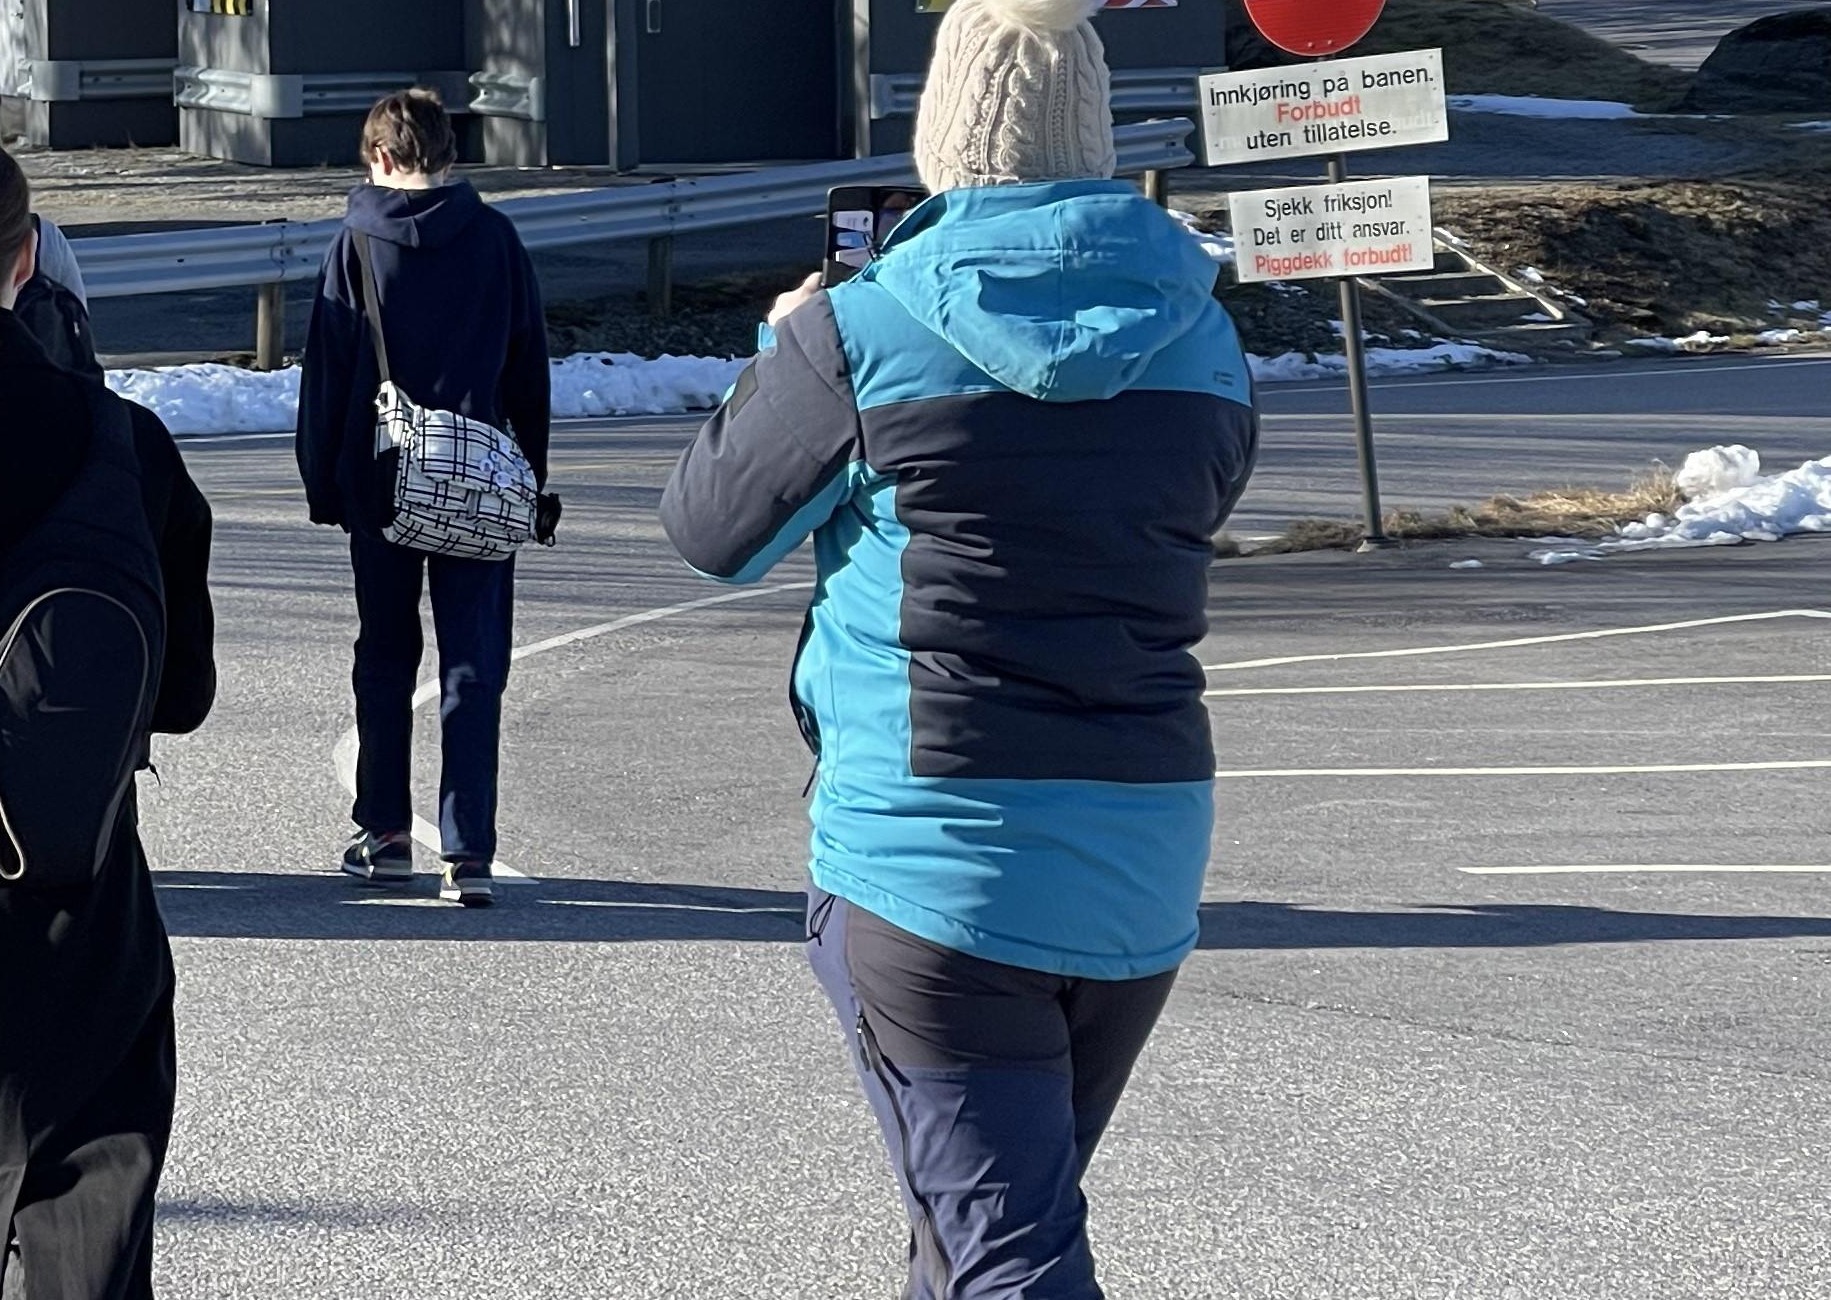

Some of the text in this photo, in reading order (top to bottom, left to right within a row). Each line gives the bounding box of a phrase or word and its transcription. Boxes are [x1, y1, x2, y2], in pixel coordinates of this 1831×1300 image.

[1209, 79, 1312, 106] Innkjøring
[1361, 67, 1434, 89] banen.
[1277, 94, 1362, 123] Forbudt
[1246, 130, 1292, 150] uten
[1303, 118, 1397, 144] tillatelse.
[1264, 189, 1393, 221] Sjekk friksjon!
[1253, 220, 1410, 246] Det er ditt ansvar.
[1254, 243, 1414, 276] Piggdekk forbudt!
